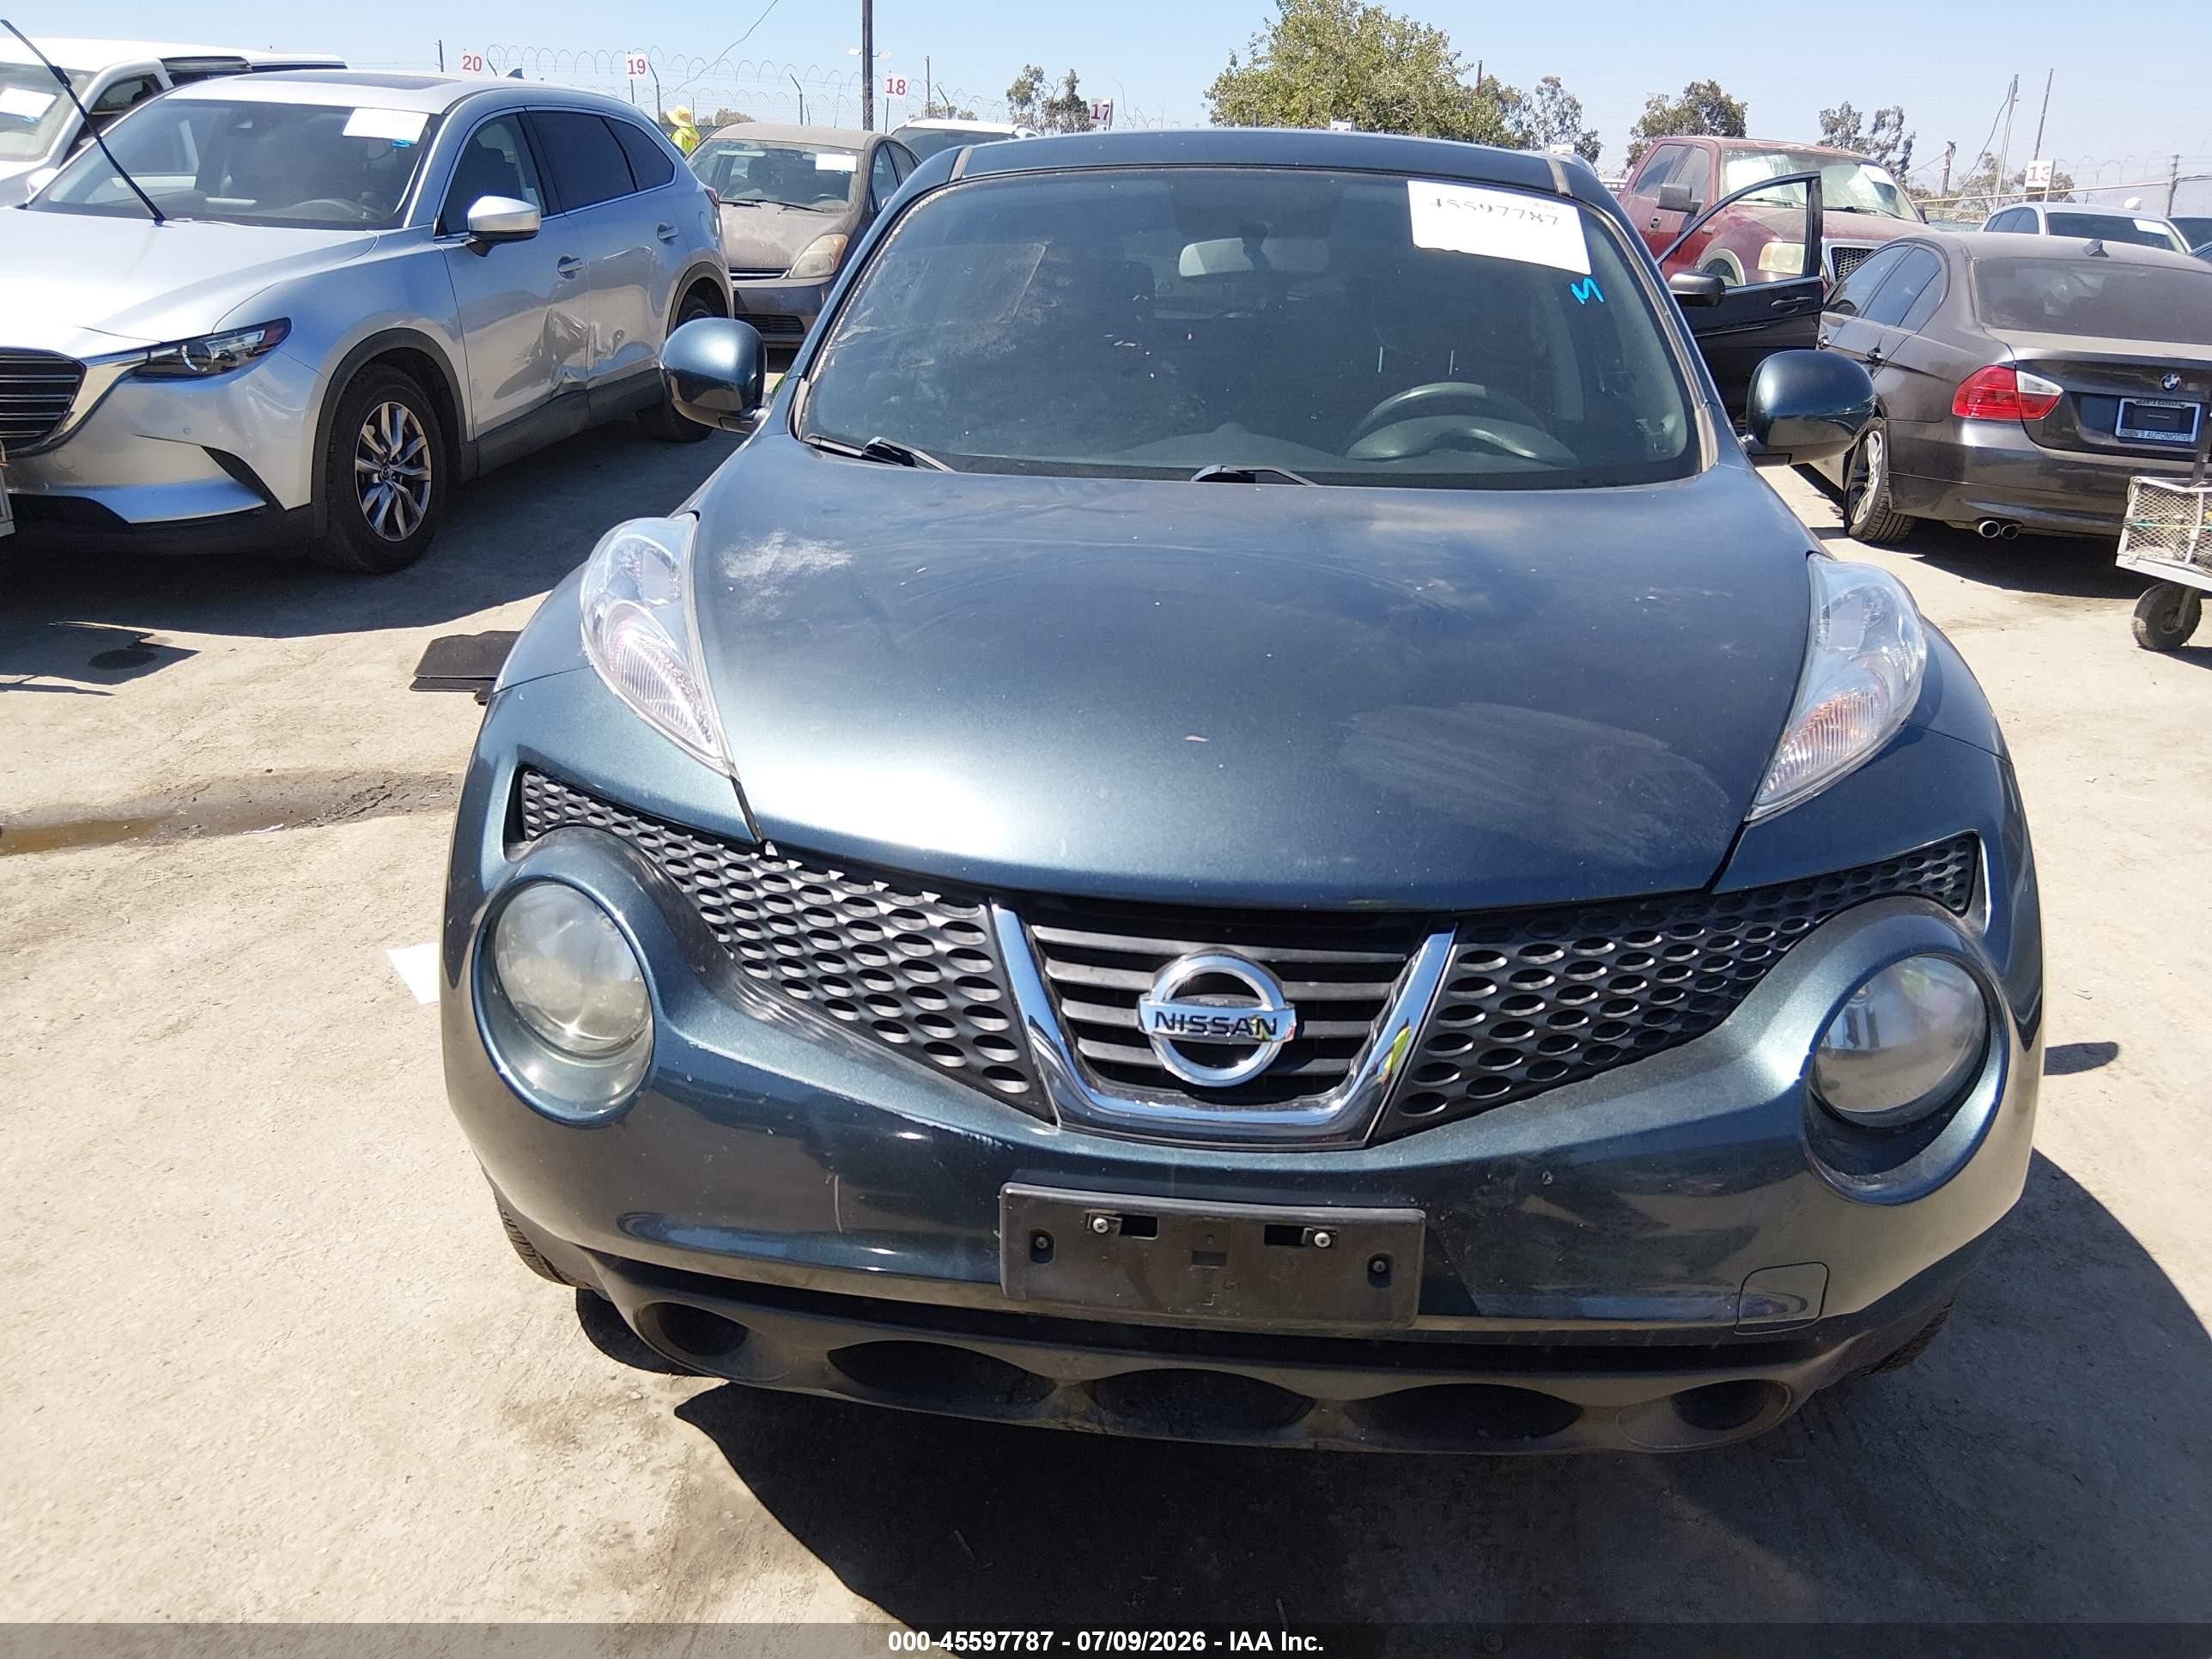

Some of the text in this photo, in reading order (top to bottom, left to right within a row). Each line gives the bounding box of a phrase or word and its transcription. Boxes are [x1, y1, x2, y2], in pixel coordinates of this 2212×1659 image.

[462, 55, 483, 71] 20
[627, 58, 646, 75] 19
[885, 78, 906, 95] 18
[1091, 102, 1110, 121] 17
[2027, 166, 2051, 182] 13
[2147, 431, 2192, 441] AUTOMOTIVE
[1155, 1011, 1277, 1036] NISSAN
